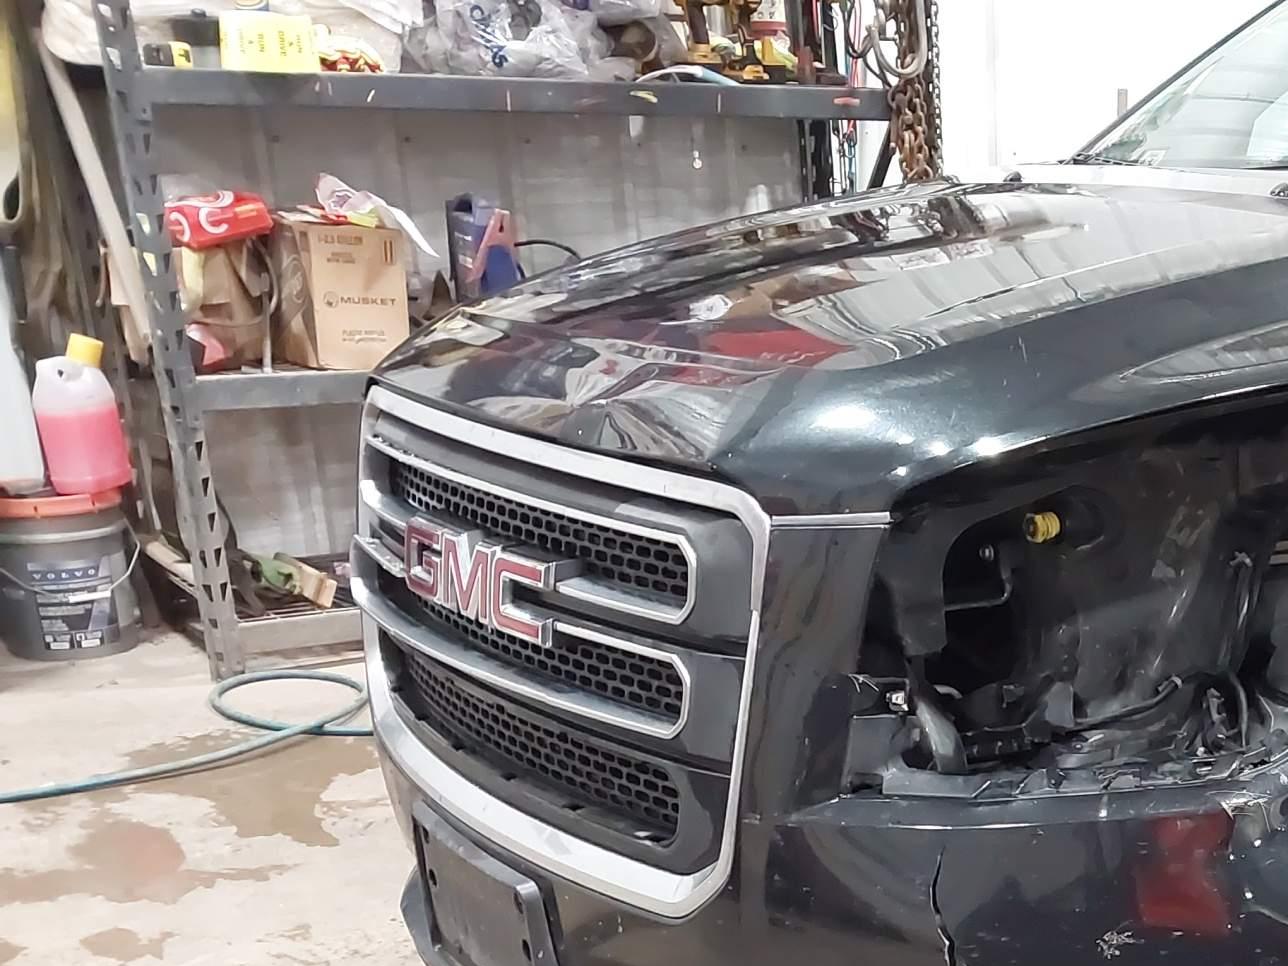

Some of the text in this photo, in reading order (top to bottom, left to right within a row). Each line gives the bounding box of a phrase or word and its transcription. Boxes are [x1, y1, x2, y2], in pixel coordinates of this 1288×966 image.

[340, 296, 397, 306] MUSKET
[32, 568, 96, 580] VOLVO
[403, 516, 555, 648] GMC
